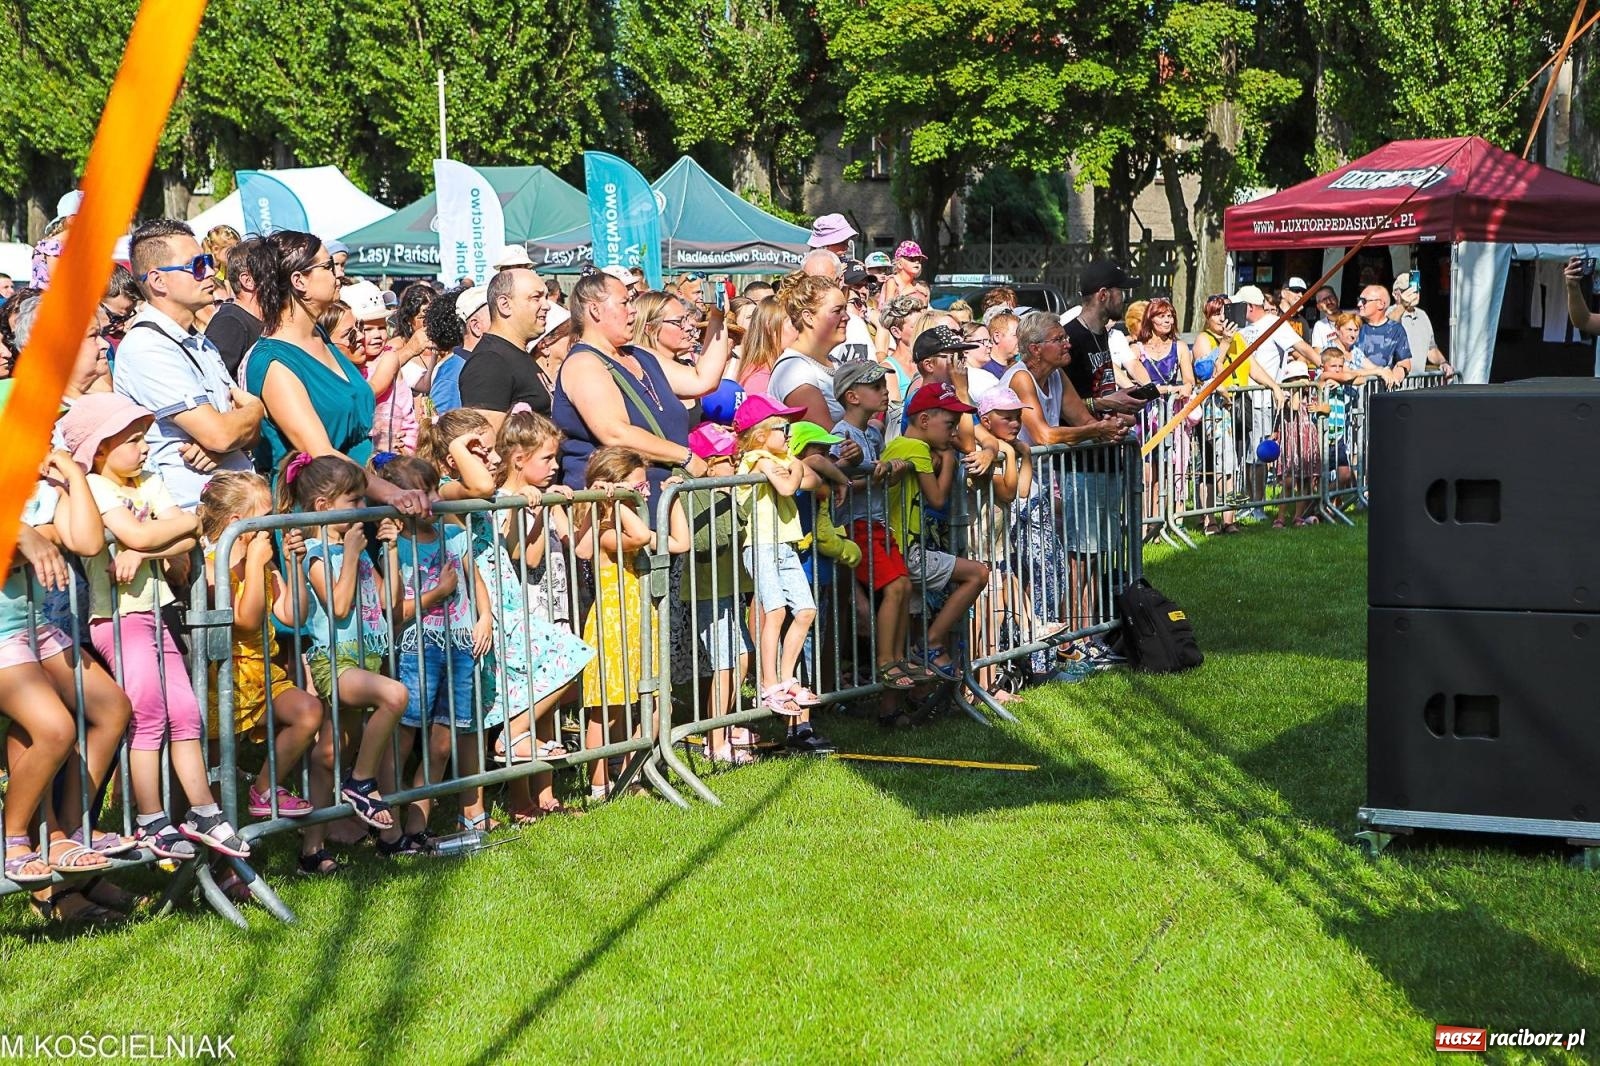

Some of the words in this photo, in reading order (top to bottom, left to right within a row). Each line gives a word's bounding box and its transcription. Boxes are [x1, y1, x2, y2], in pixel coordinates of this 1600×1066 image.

[358, 246, 392, 267] Lasy
[543, 247, 575, 267] Lasy
[677, 249, 750, 264] Nadleśnictwo
[751, 249, 781, 264] Rudy
